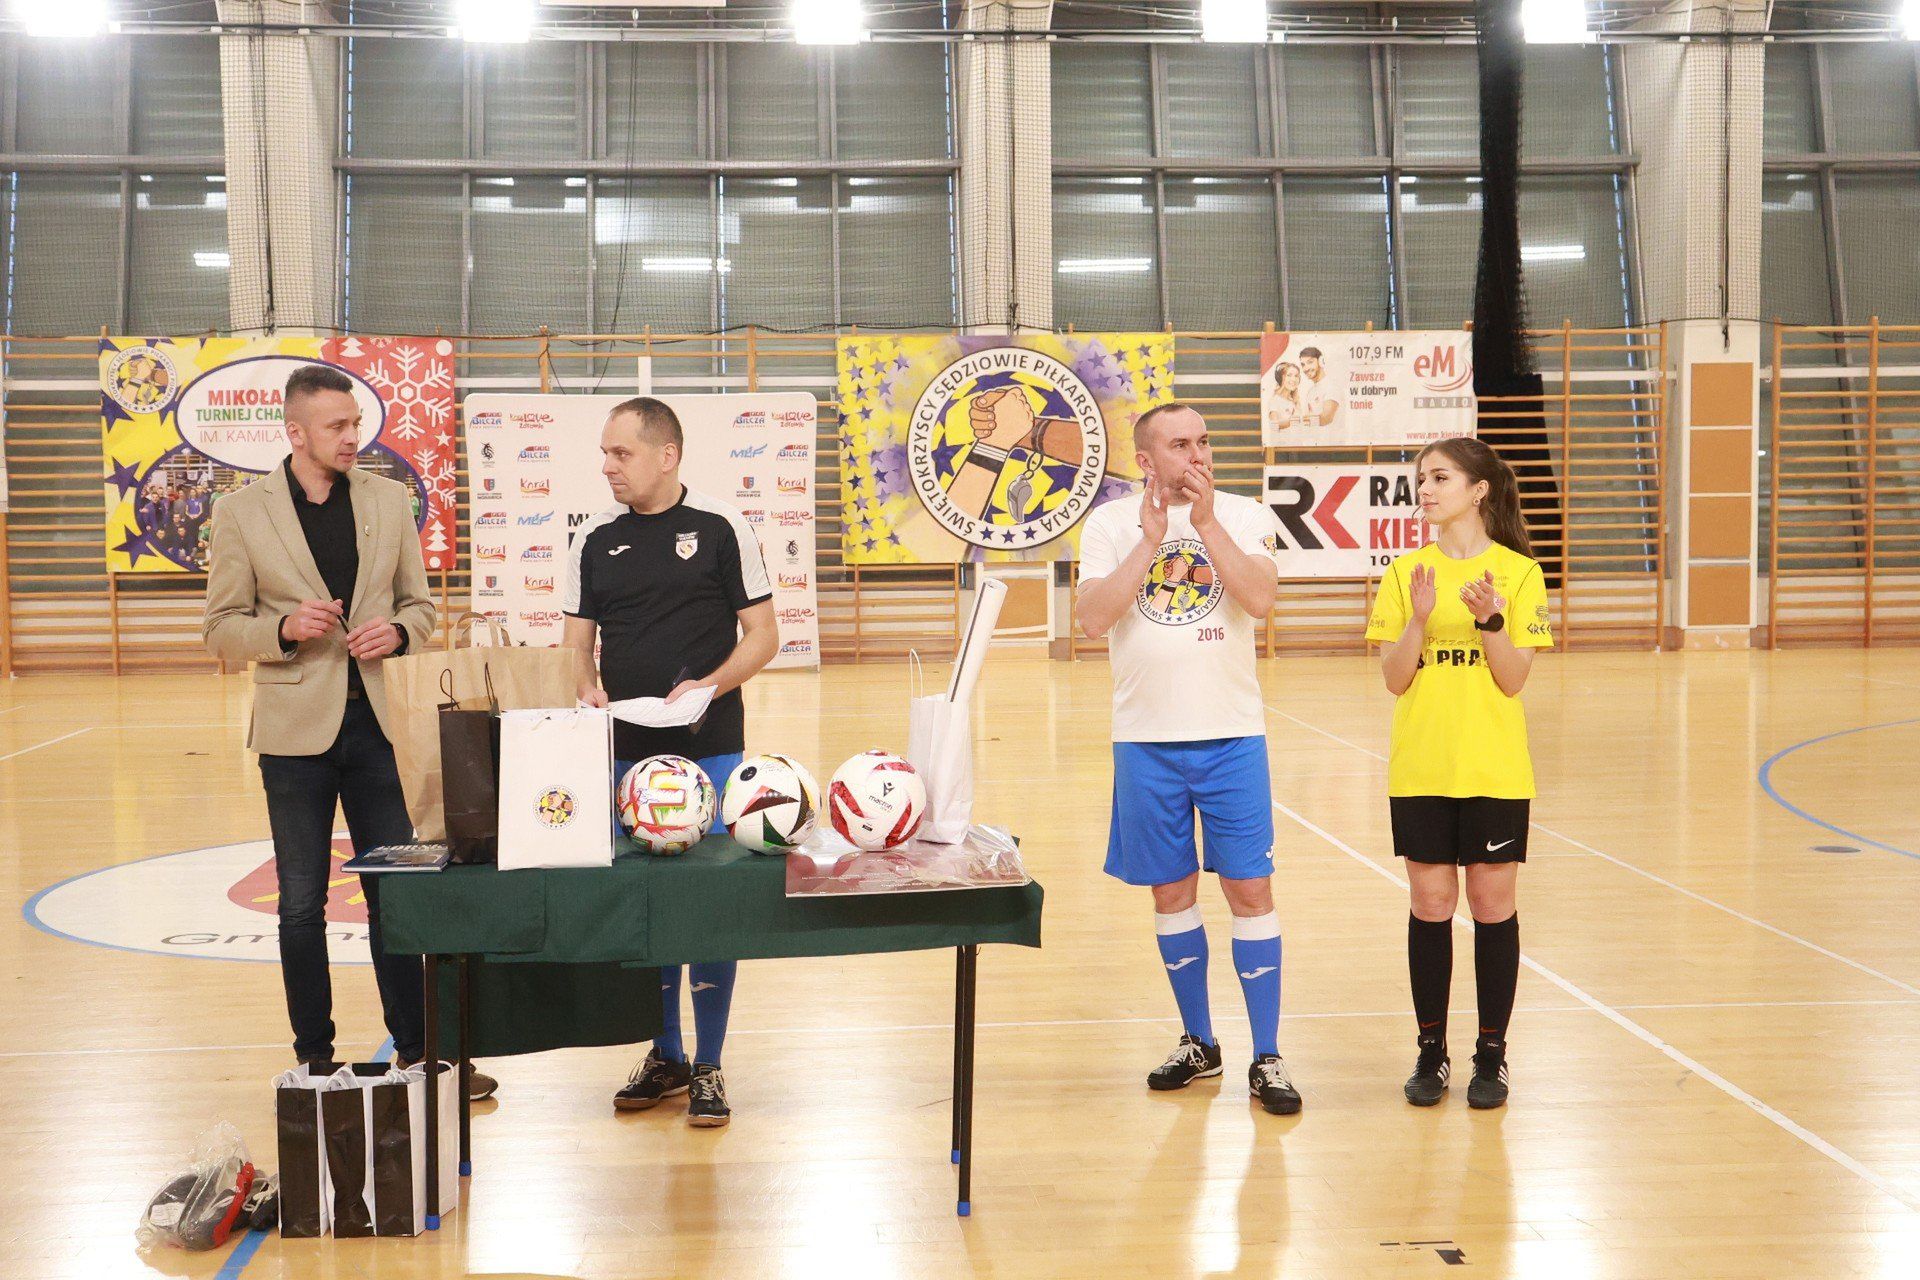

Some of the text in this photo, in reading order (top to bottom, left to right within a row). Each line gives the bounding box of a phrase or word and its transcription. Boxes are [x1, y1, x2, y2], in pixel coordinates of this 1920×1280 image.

[1349, 346, 1404, 361] 107,9 FM
[1413, 345, 1456, 377] eM
[1349, 371, 1385, 382] Zawsze
[208, 389, 283, 406] MIKOŁA
[1350, 385, 1398, 397] w dobrym
[1350, 400, 1373, 410] tonie
[1416, 398, 1470, 408] RADIO
[196, 408, 285, 421] TURNIEJ CHA
[226, 430, 285, 443] KAMILA
[913, 353, 1101, 537] ŚWIĘTOKRZYSCY SĘDZIOWIE PIŁKARSCY POMAGAJĄ
[1370, 475, 1420, 506] RA
[1370, 518, 1437, 549] KIEL
[1370, 555, 1400, 566] 10
[1197, 627, 1225, 642] 2016
